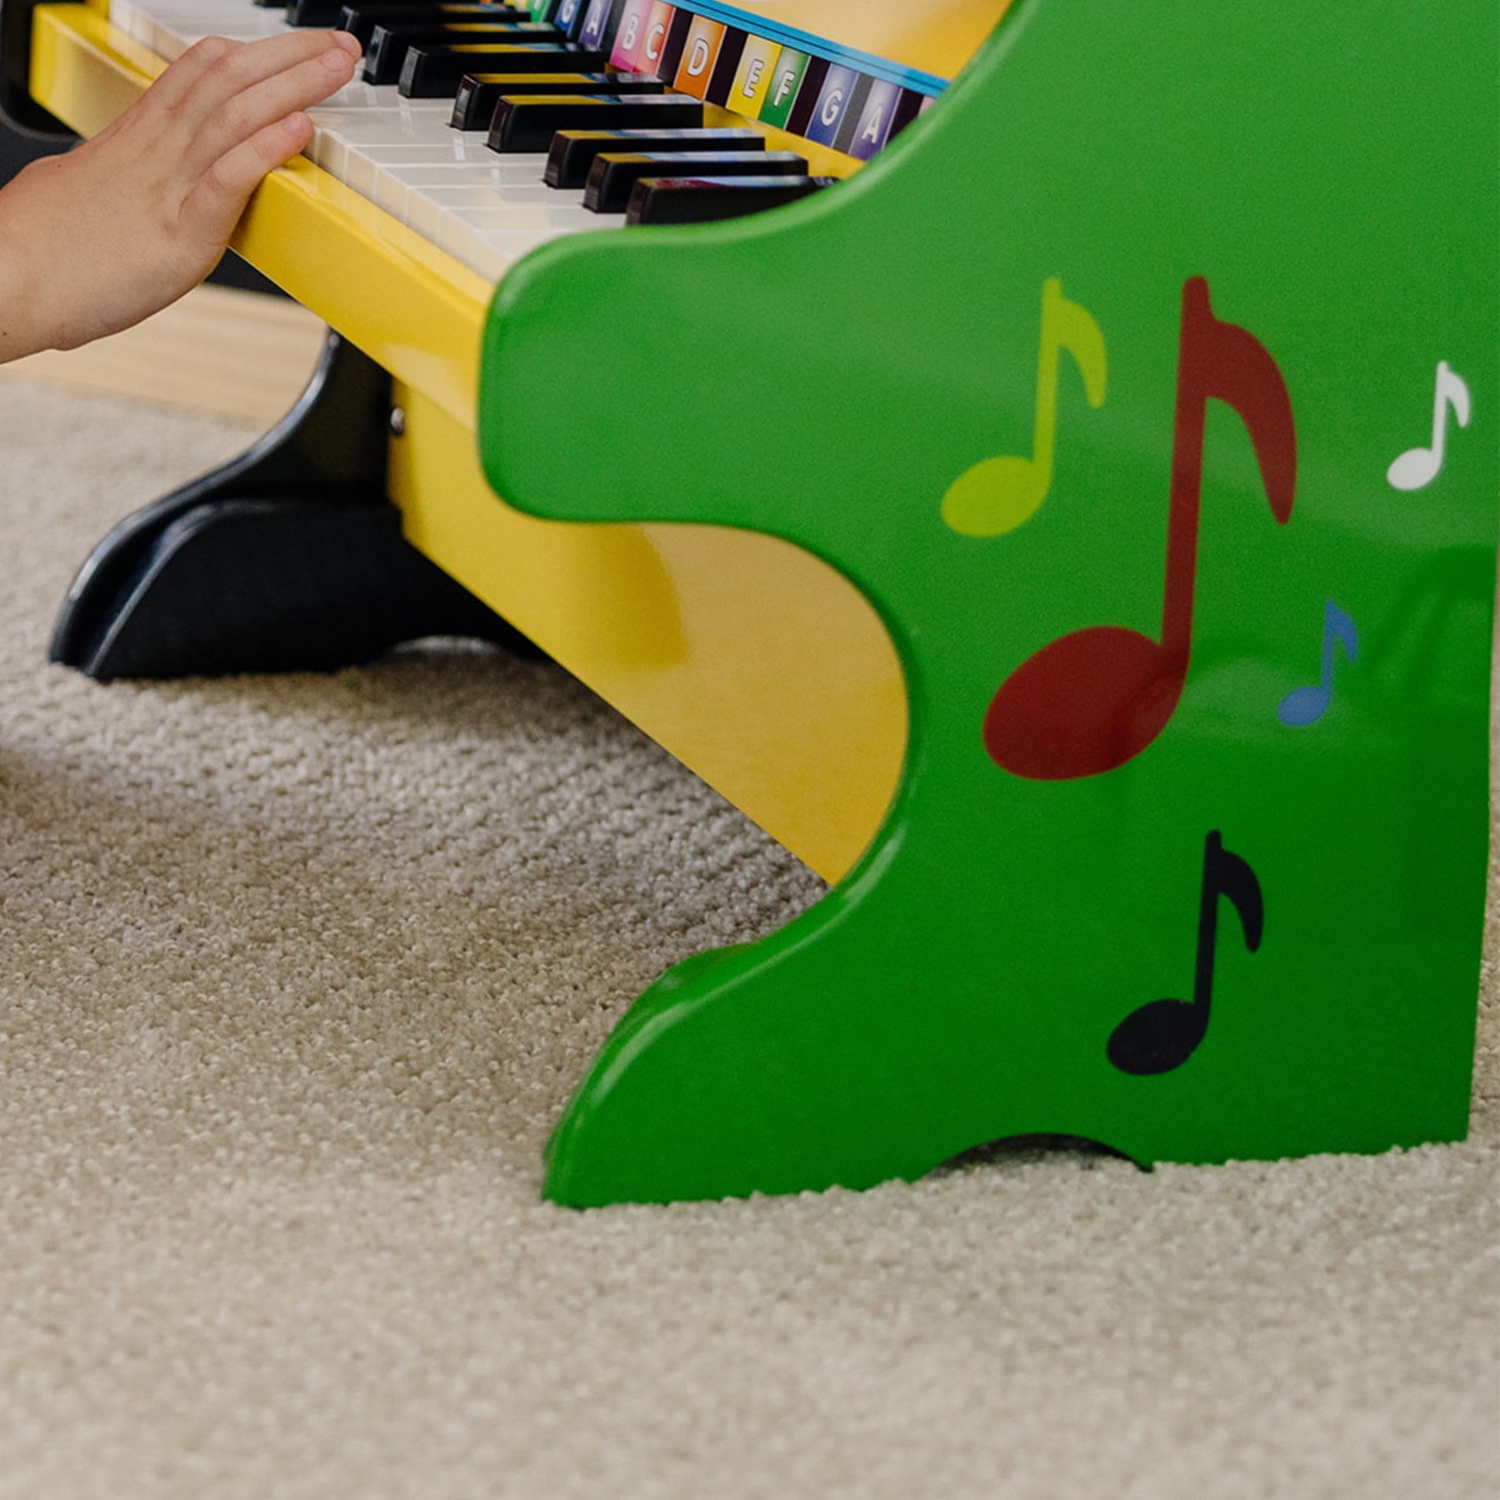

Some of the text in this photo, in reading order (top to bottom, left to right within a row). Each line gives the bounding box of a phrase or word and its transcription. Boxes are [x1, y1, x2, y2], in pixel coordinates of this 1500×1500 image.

[585, 5, 600, 37] A
[621, 12, 640, 51] B
[645, 23, 665, 60] C
[686, 36, 709, 77] D
[743, 58, 765, 99] E
[772, 69, 796, 109] F
[819, 87, 843, 127] G
[861, 105, 883, 145] A
